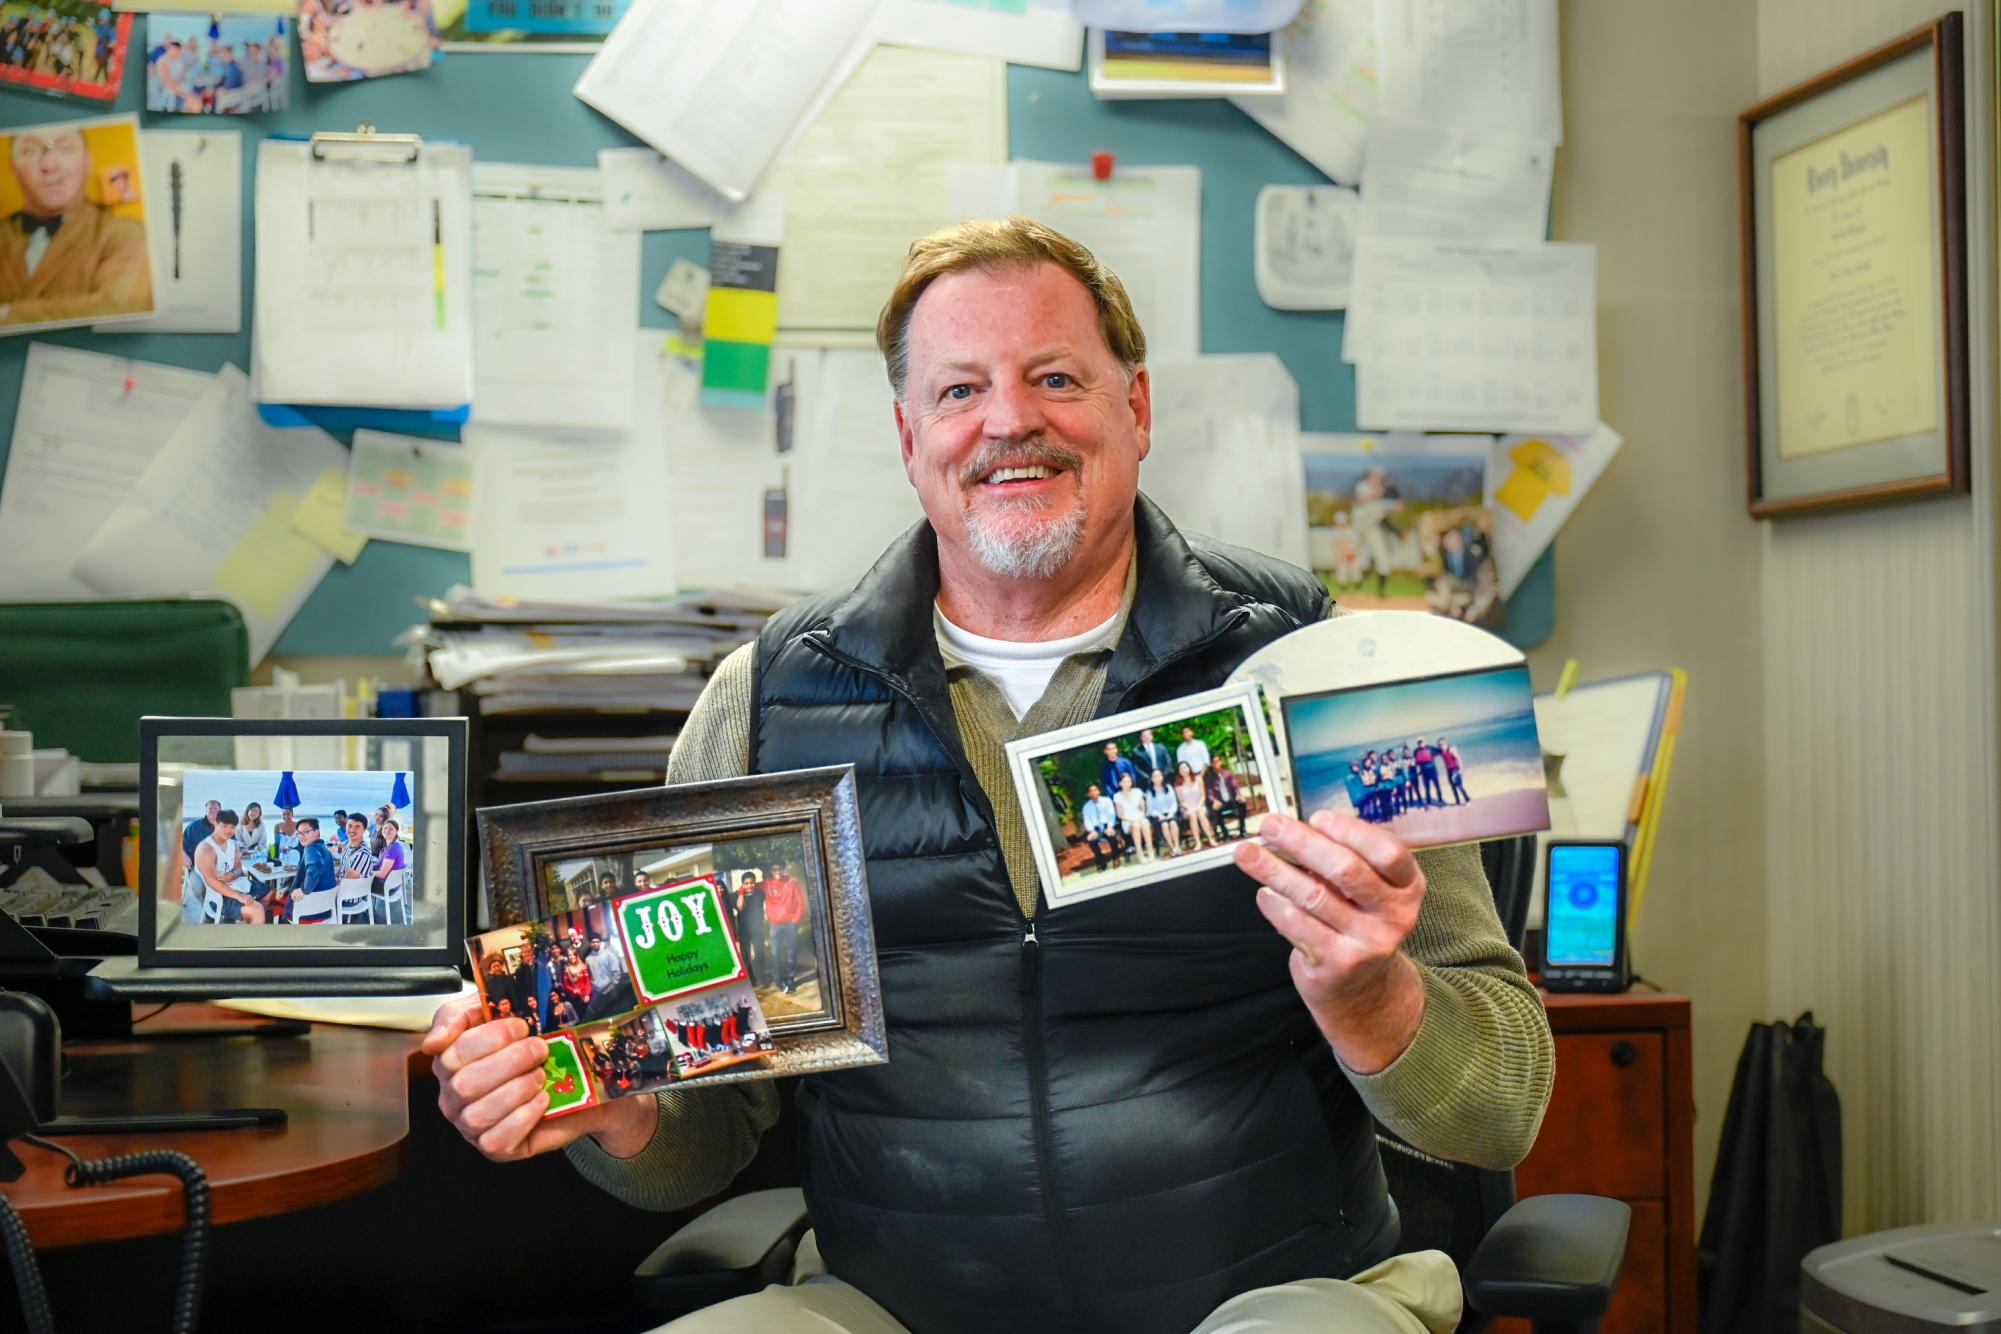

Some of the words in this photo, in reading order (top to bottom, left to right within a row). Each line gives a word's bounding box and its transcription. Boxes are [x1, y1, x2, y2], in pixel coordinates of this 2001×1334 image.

[635, 892, 712, 949] JOY
[667, 950, 698, 964] Happy
[667, 963, 708, 978] Holidays
